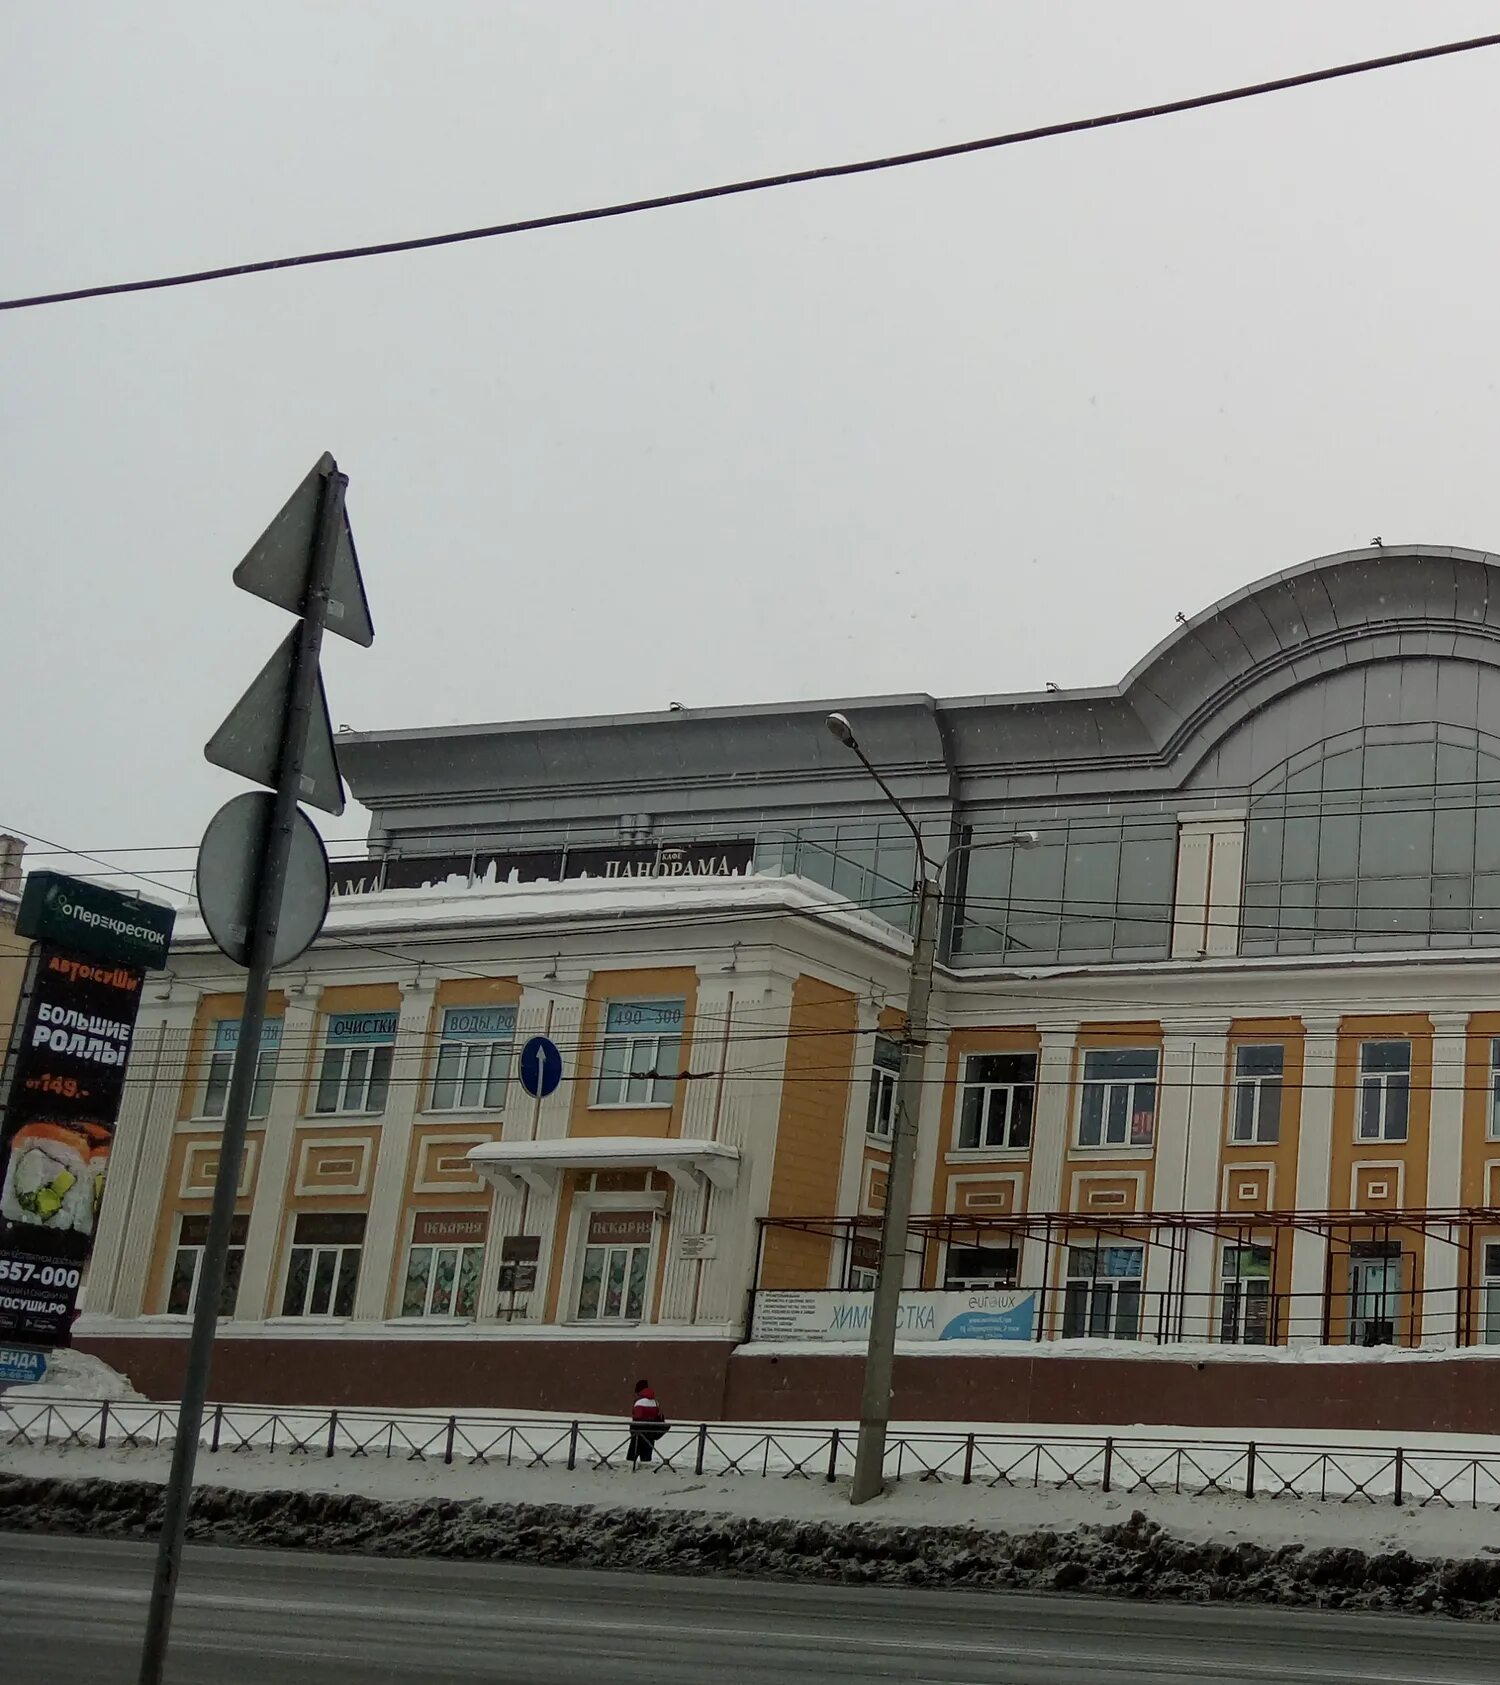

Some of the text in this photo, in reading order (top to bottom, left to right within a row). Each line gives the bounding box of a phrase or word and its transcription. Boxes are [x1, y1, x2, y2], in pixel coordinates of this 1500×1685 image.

[605, 855, 731, 879] ПАНОРАМА
[72, 905, 166, 945] Перекресток
[38, 1002, 131, 1041] БОЛЬШИЕ
[334, 1019, 398, 1036] ОЧИСТКИ
[32, 1025, 127, 1067] РОЛЛЫ
[423, 1222, 483, 1235] ПЕКАРНЯ
